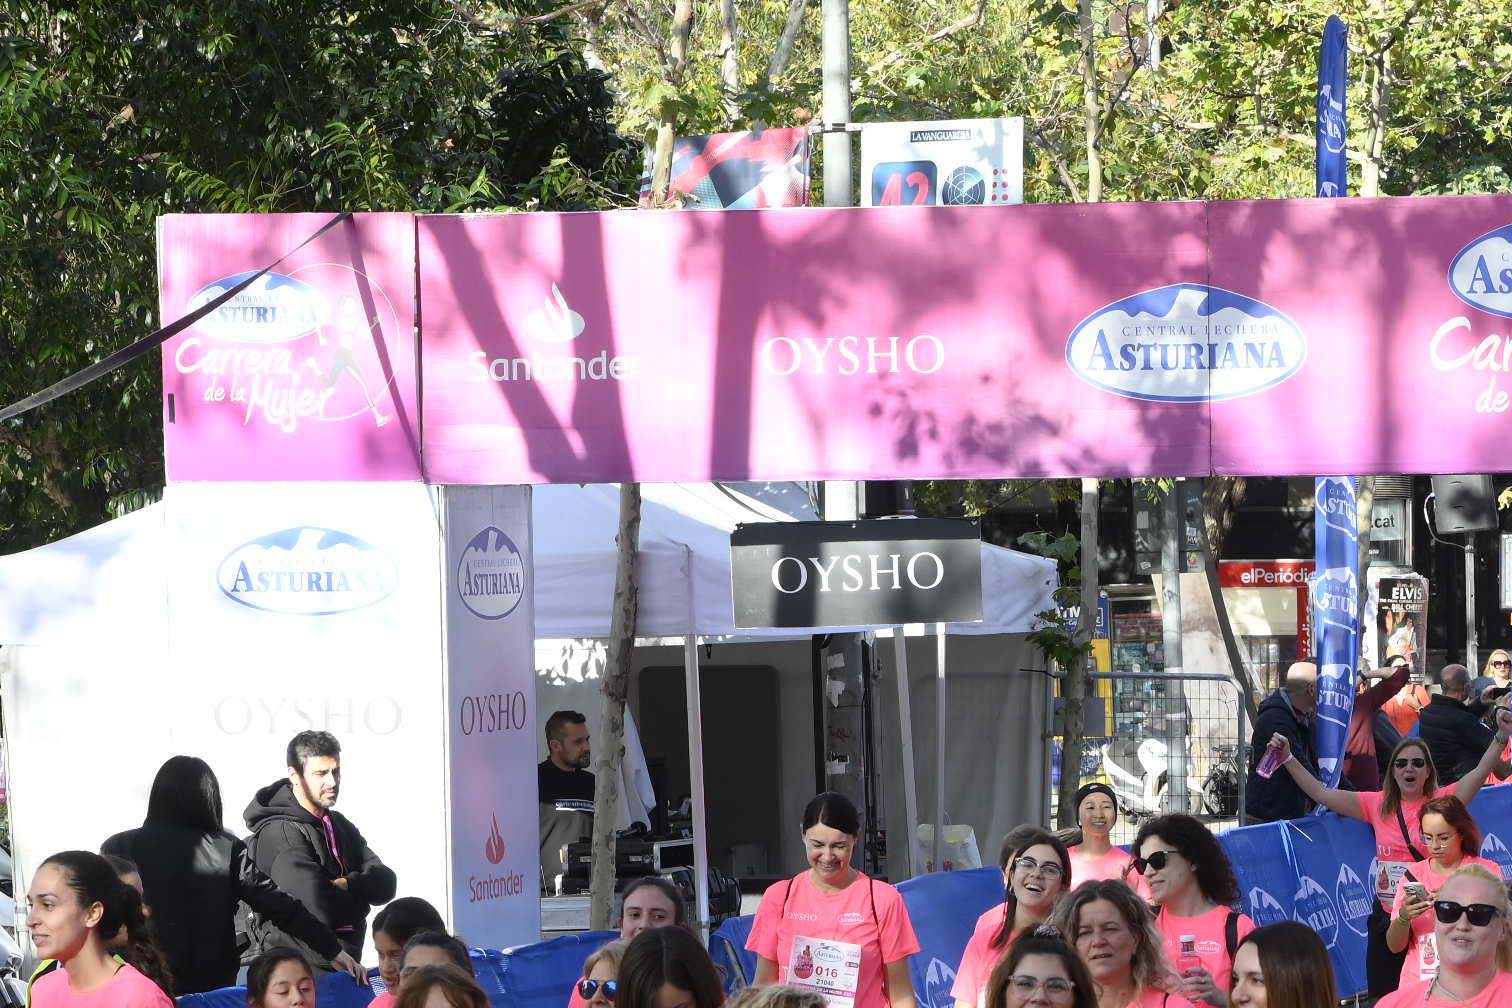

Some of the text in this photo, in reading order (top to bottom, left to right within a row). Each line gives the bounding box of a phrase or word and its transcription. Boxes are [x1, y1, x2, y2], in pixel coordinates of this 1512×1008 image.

[1121, 325, 1196, 337] CENTRAL
[174, 338, 292, 376] Carrera
[762, 334, 945, 377] OYSHO
[1086, 328, 1287, 371] ASTURIANA
[204, 379, 226, 403] de
[242, 369, 336, 433] Mujer
[1475, 380, 1511, 413] de
[463, 564, 521, 598] ASTURIANA
[770, 551, 945, 594] OYSHO
[1391, 587, 1425, 600] ELVIS
[460, 691, 527, 736] OYSHO
[469, 872, 525, 904] Santander
[815, 966, 839, 978] 016
